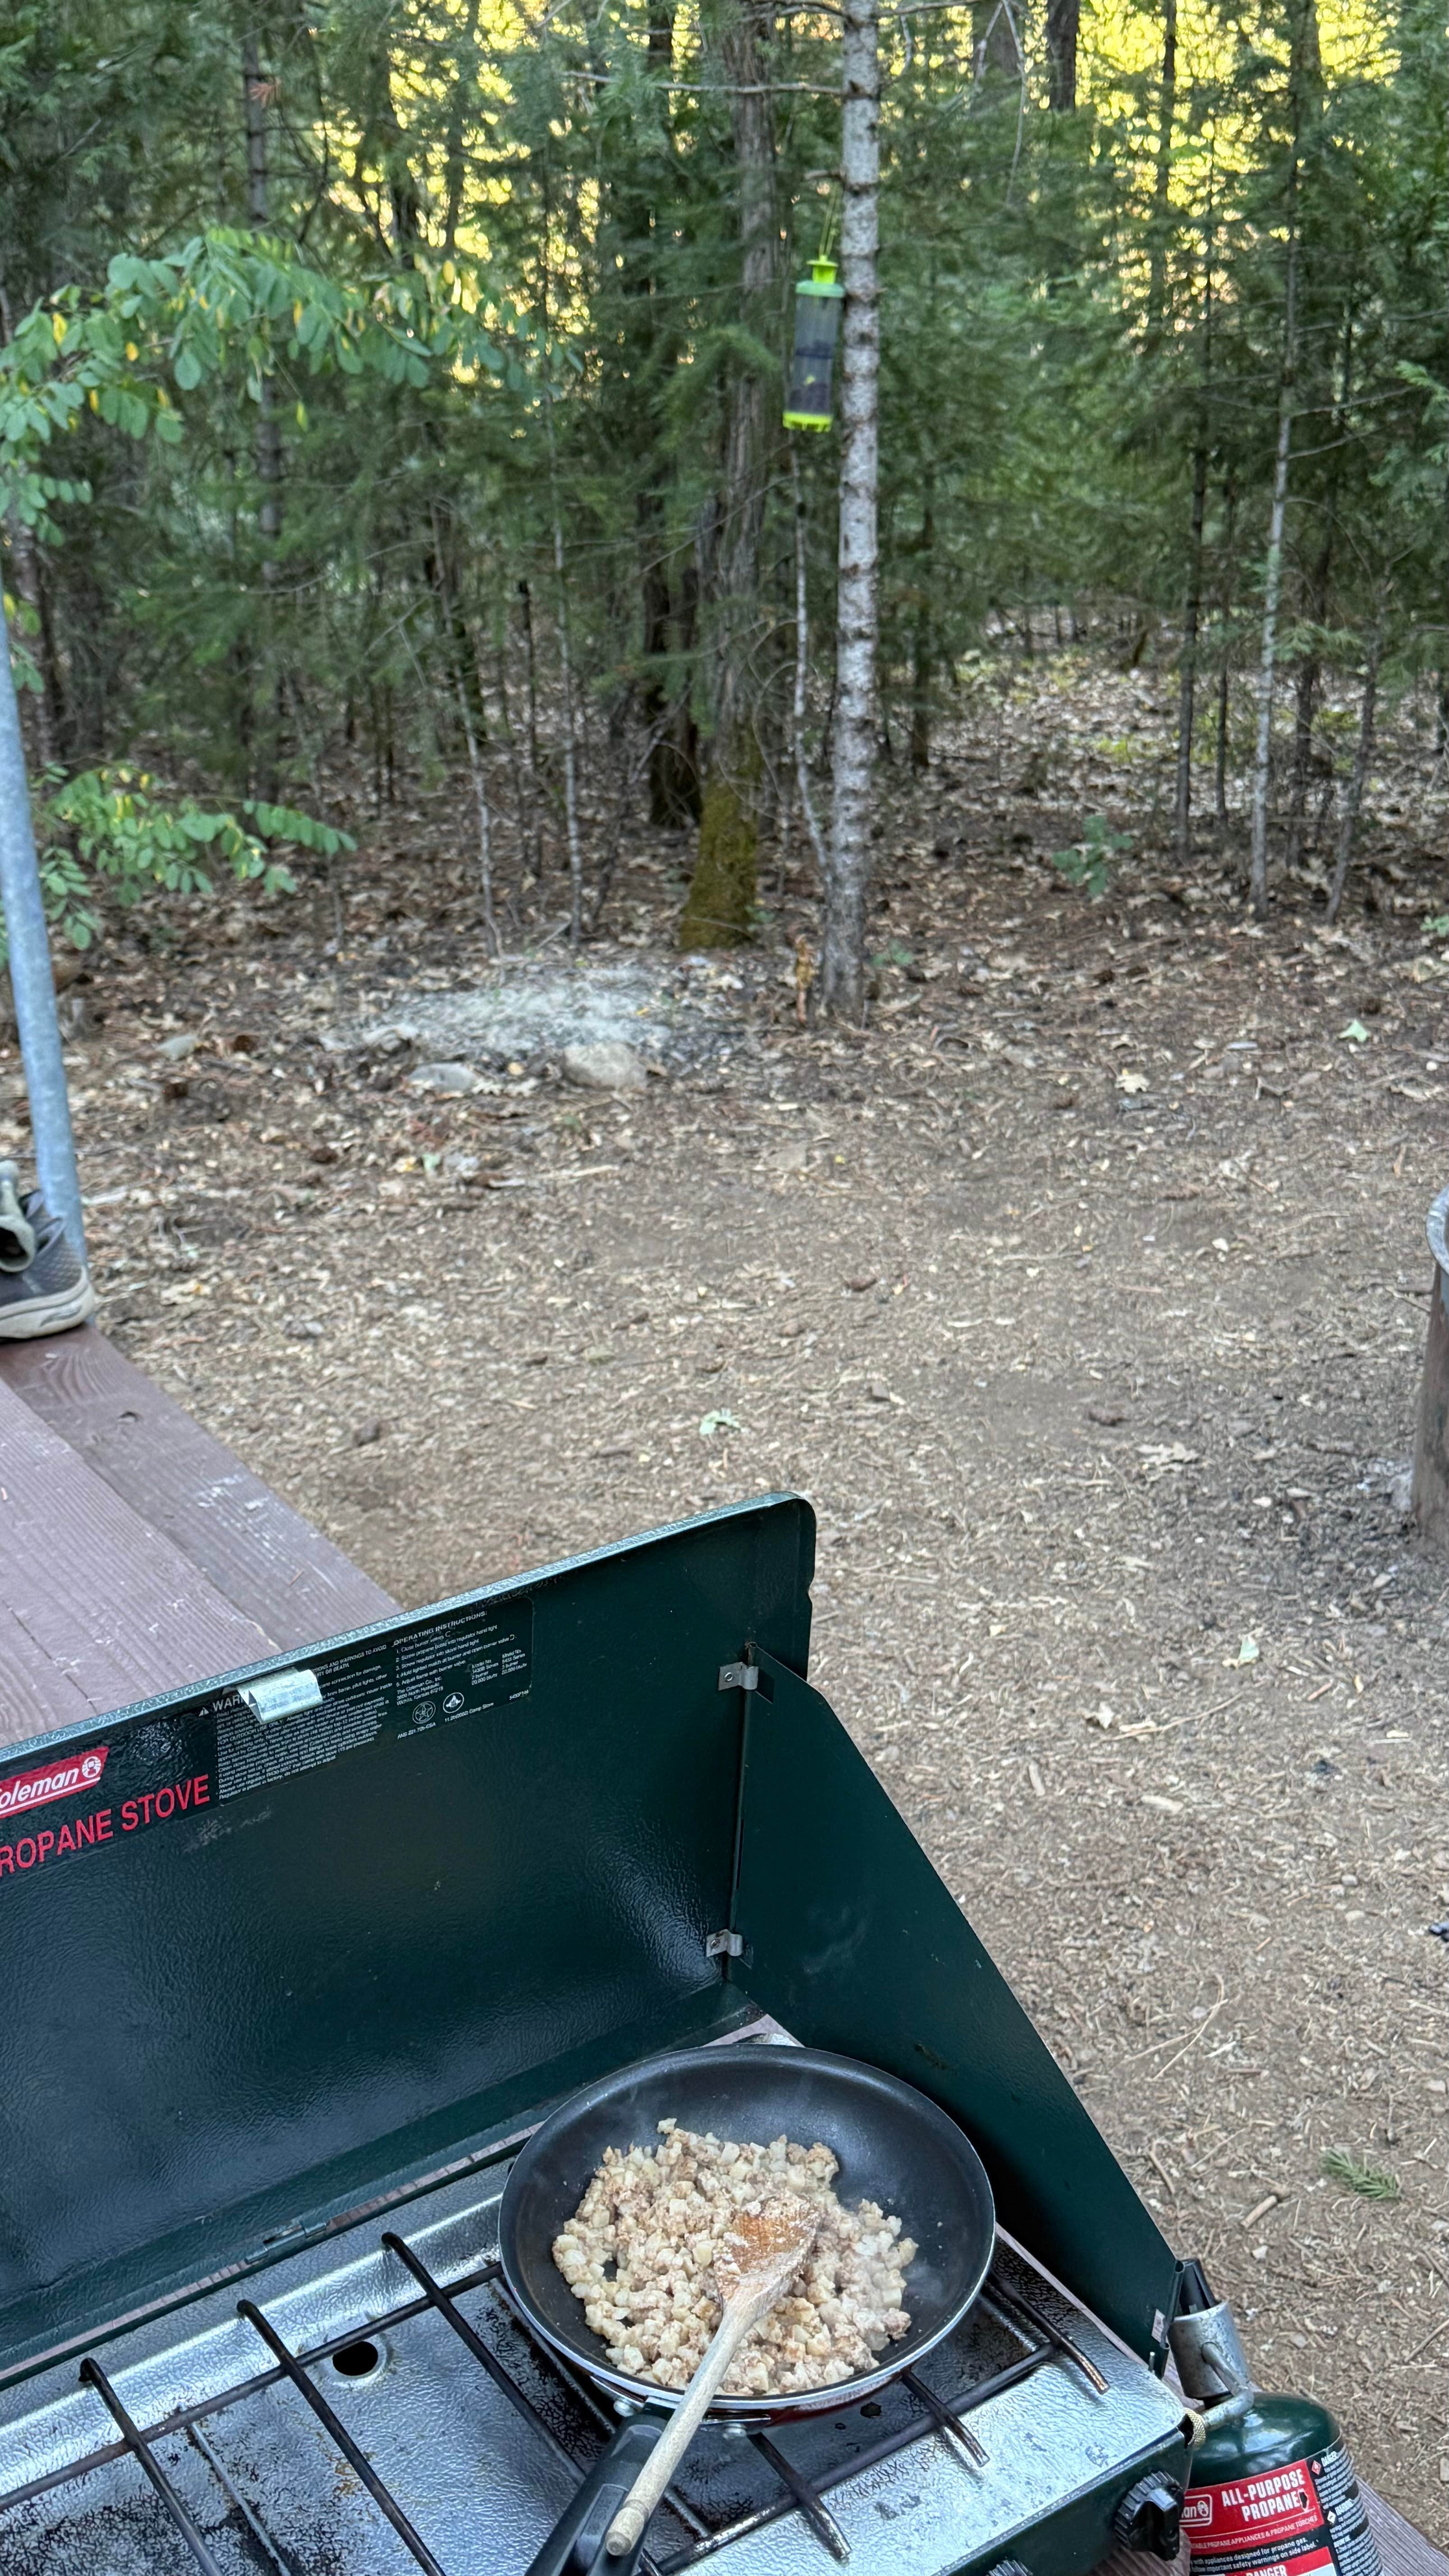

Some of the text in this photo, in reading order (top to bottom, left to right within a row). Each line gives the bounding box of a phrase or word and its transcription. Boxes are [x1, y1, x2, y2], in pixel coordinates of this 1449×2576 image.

[394, 1628, 433, 1646] OPERATING
[212, 1694, 244, 1712] WAR
[0, 1768, 79, 1808] oleman
[0, 1774, 210, 1877] ROPANE STOVE
[1221, 2468, 1305, 2507] ALL-PURPOSE
[1181, 2506, 1197, 2518] an
[1242, 2490, 1300, 2522] PROPANE
[1231, 2532, 1265, 2545] APPLIANCES
[1271, 2523, 1294, 2536] PROPANE
[1295, 2515, 1318, 2530] TORCHES
[1233, 2560, 1251, 2571] safety
[1252, 2553, 1279, 2566] warnings
[1289, 2546, 1301, 2556] side
[1302, 2541, 1316, 2552] label.
[1234, 2550, 1260, 2561] designed
[1261, 2546, 1270, 2555] for
[1271, 2541, 1295, 2553] propane
